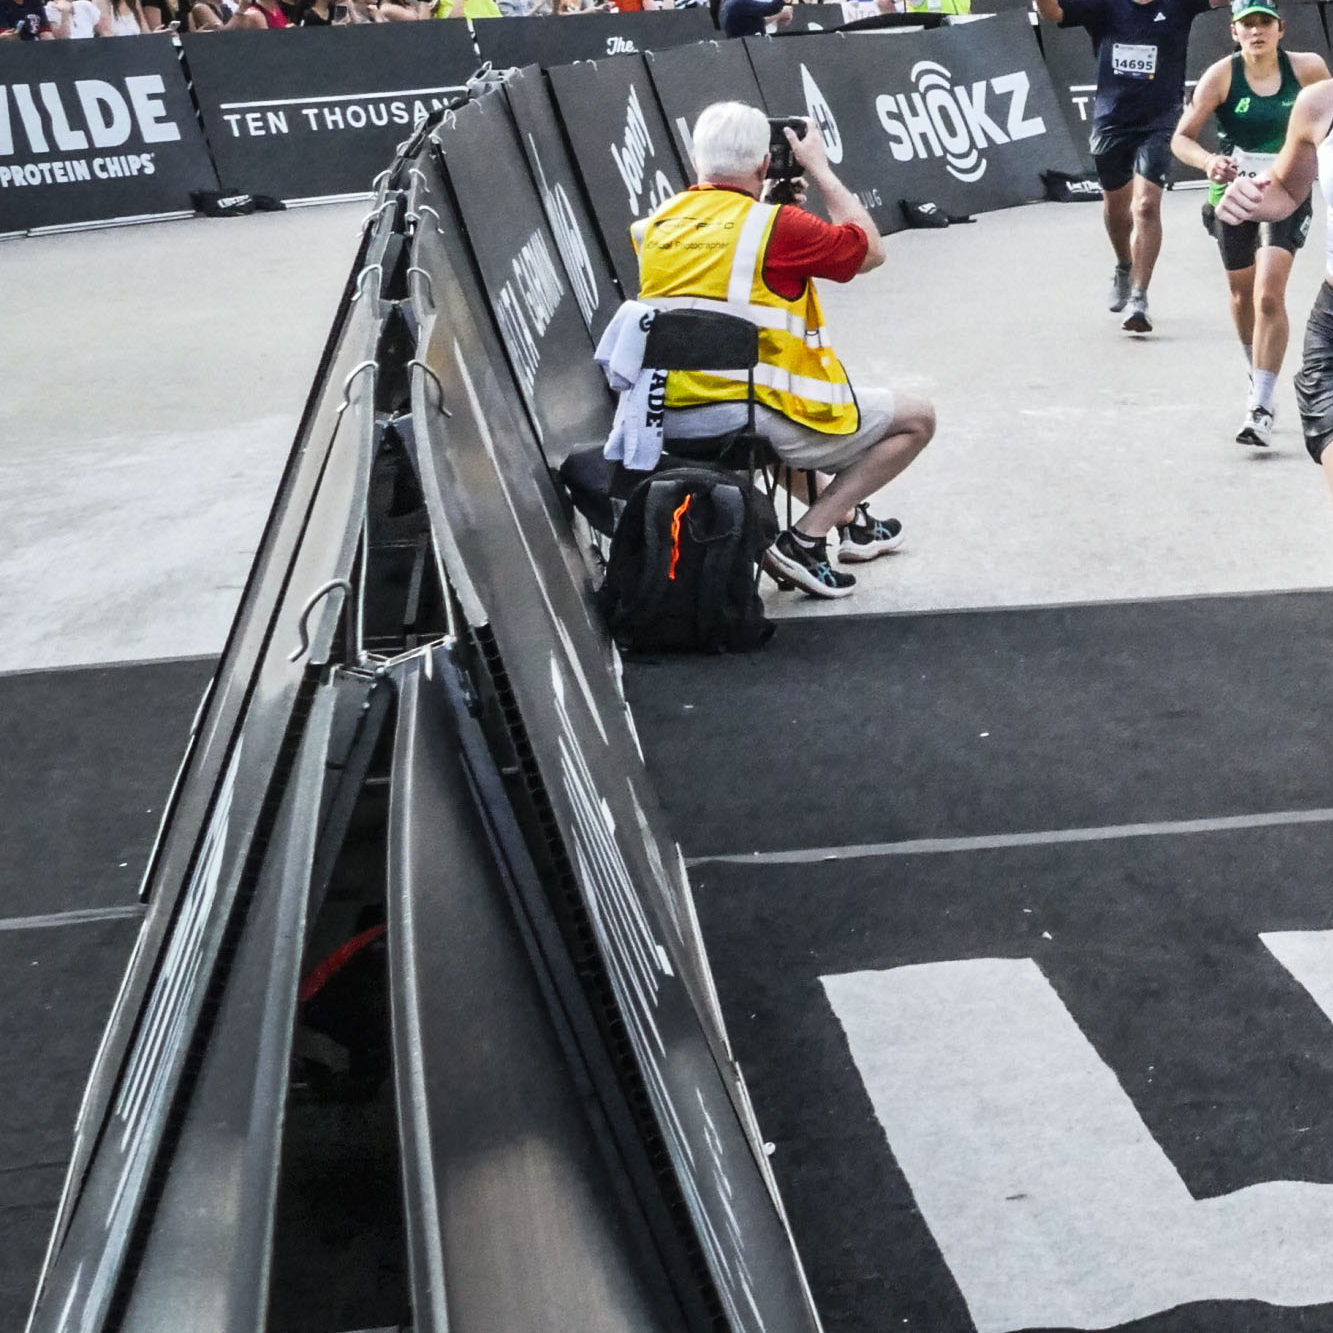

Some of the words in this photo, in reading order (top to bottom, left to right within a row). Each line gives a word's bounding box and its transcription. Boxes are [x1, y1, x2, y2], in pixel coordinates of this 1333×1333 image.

[606, 37, 635, 55] The
[1114, 58, 1154, 71] 14695
[223, 111, 290, 138] TEN
[876, 71, 1047, 162] SHOKZ
[0, 156, 92, 188] PROTEIN
[95, 153, 155, 180] CHIPS
